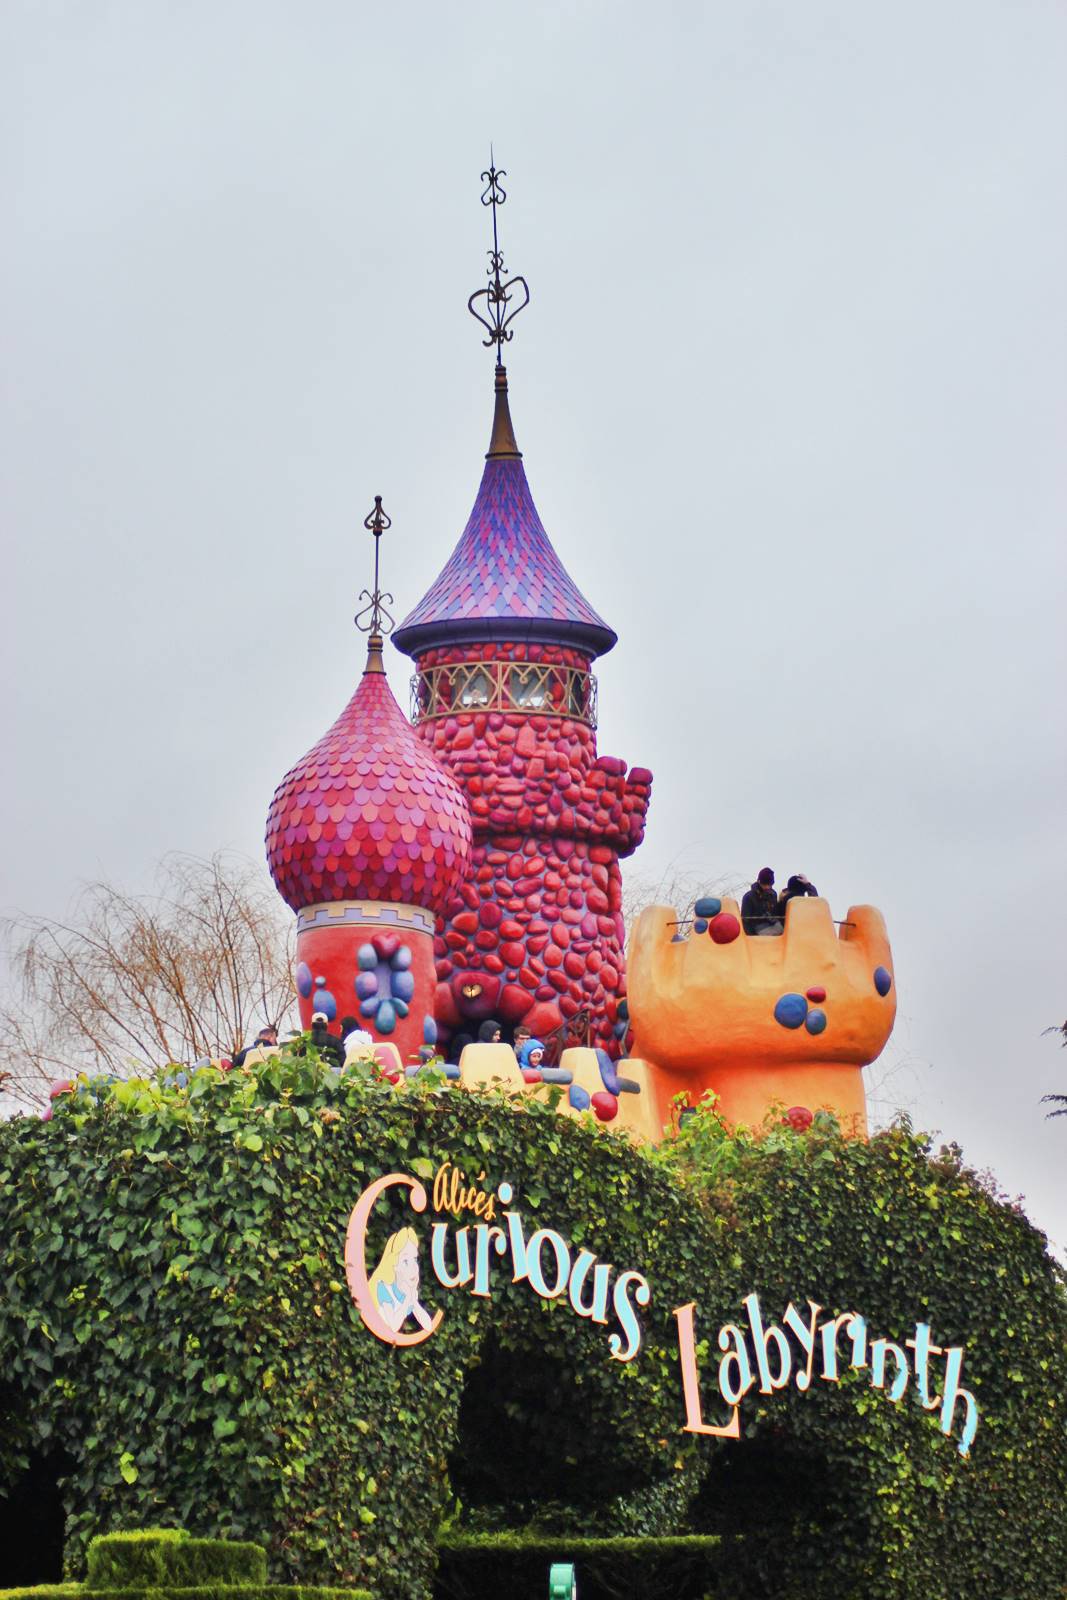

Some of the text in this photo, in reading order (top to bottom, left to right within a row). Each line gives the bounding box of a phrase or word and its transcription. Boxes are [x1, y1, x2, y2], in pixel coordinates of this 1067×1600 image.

[433, 1162, 497, 1221] Alice's
[344, 1173, 978, 1459] Curious Labyrinth
